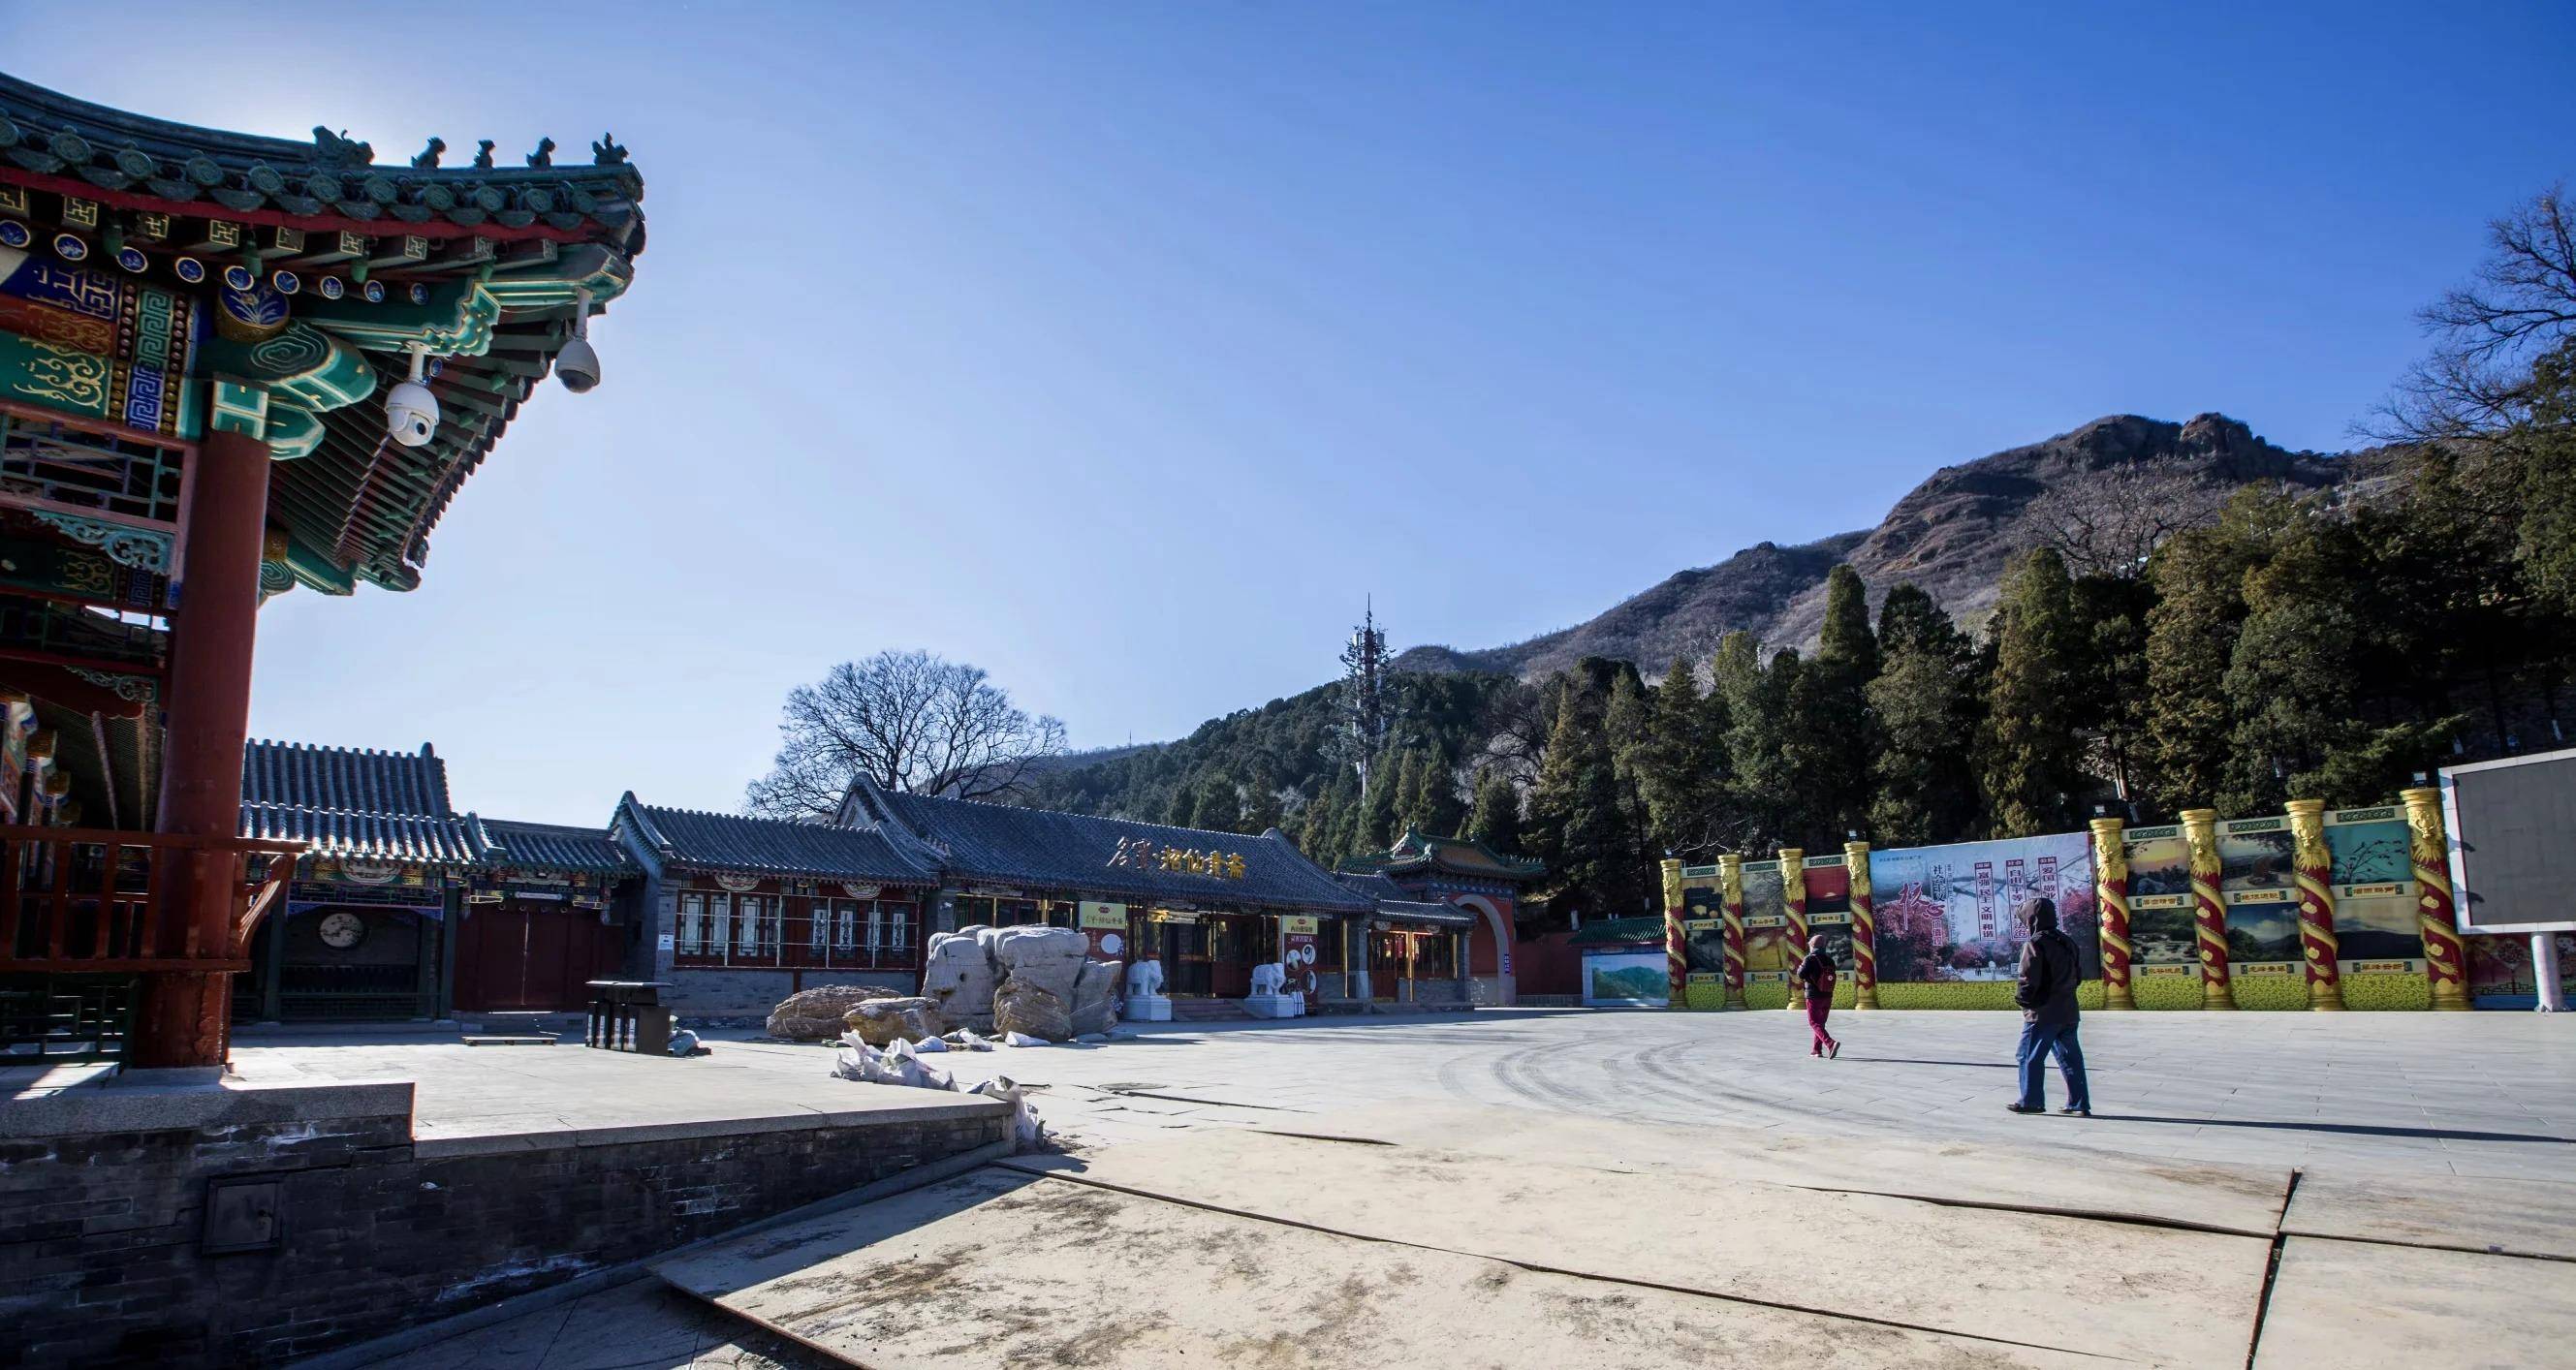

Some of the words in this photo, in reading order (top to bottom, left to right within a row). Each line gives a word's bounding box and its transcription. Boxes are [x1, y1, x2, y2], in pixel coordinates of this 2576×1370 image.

[1978, 871, 1991, 887] 富强
[2009, 870, 2022, 885] 自由
[1980, 889, 1993, 904] 民主
[2010, 887, 2024, 902] 平等
[1981, 906, 1993, 920] 文明
[1982, 923, 1994, 938] 和谐
